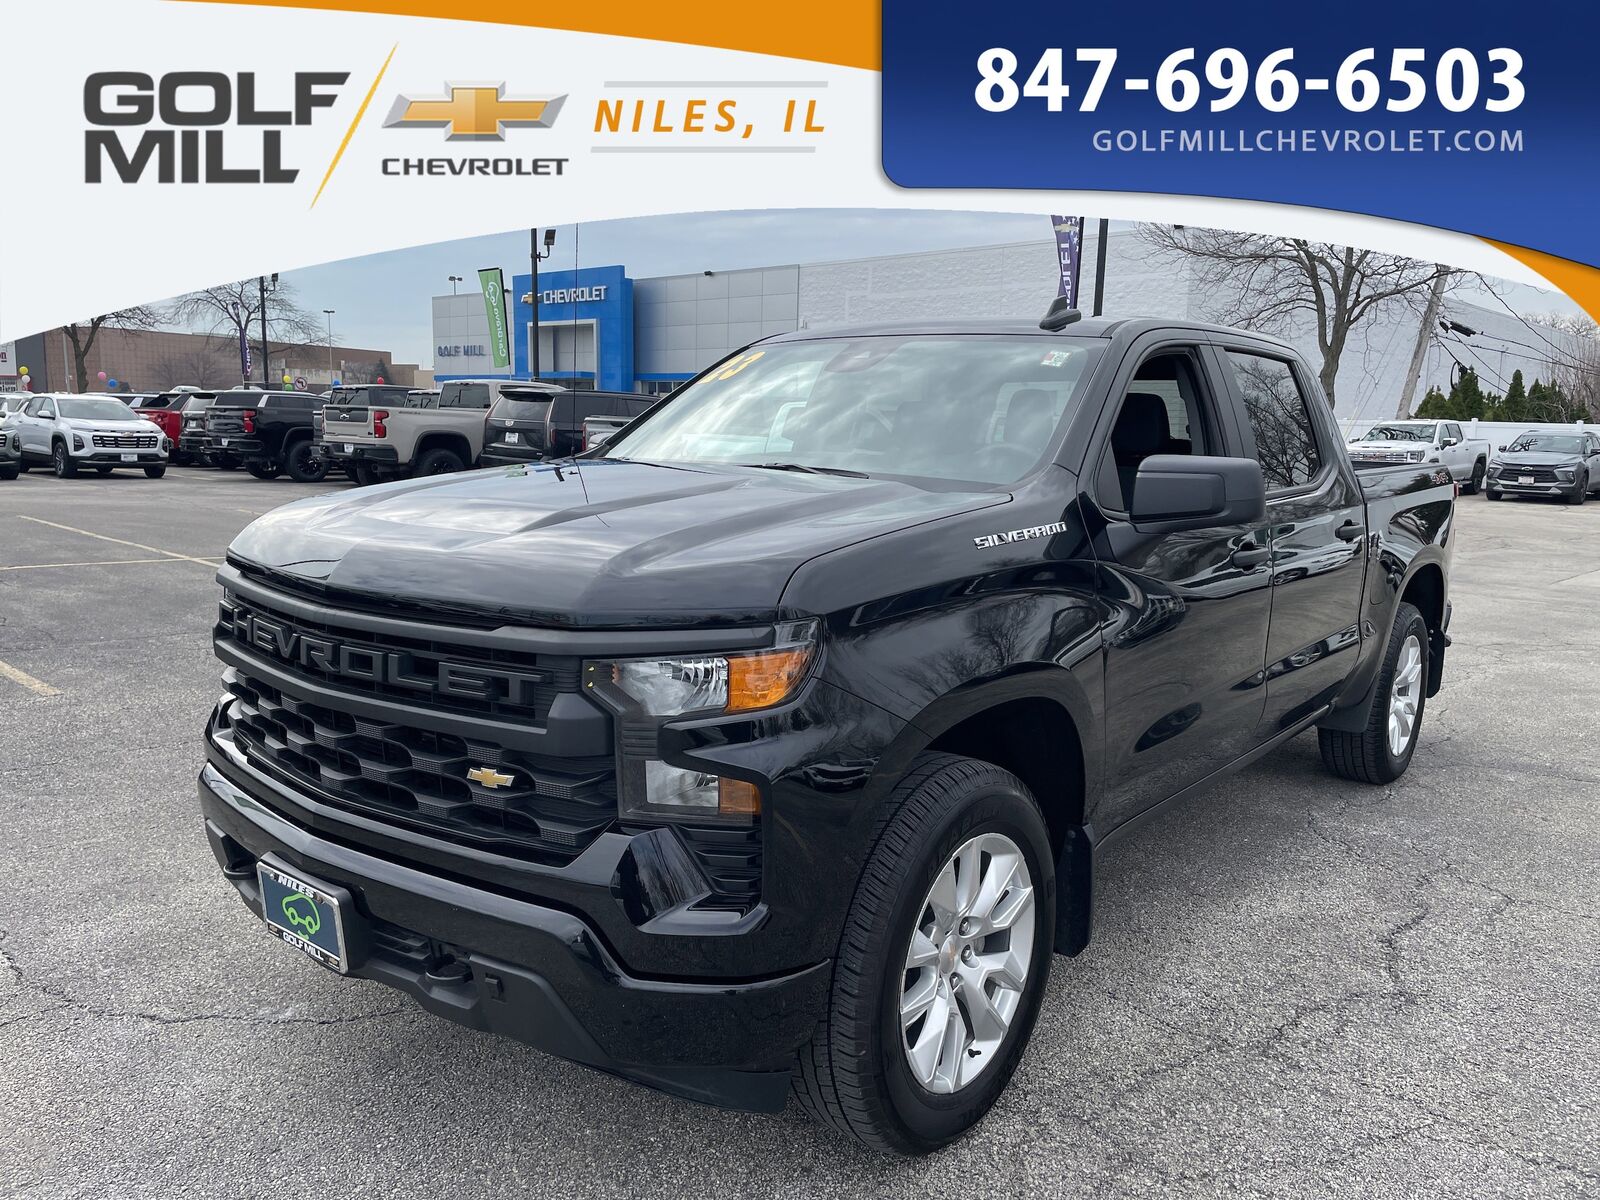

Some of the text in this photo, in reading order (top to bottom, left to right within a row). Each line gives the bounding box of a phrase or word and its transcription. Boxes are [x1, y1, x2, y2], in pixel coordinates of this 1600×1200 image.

[543, 285, 607, 304] CHEVROLET
[438, 344, 486, 357] GOLF MILL
[973, 521, 1068, 550] SILVERADO
[218, 599, 546, 707] CHEVROLET
[277, 875, 315, 899] NILES
[282, 931, 304, 950] GOLF
